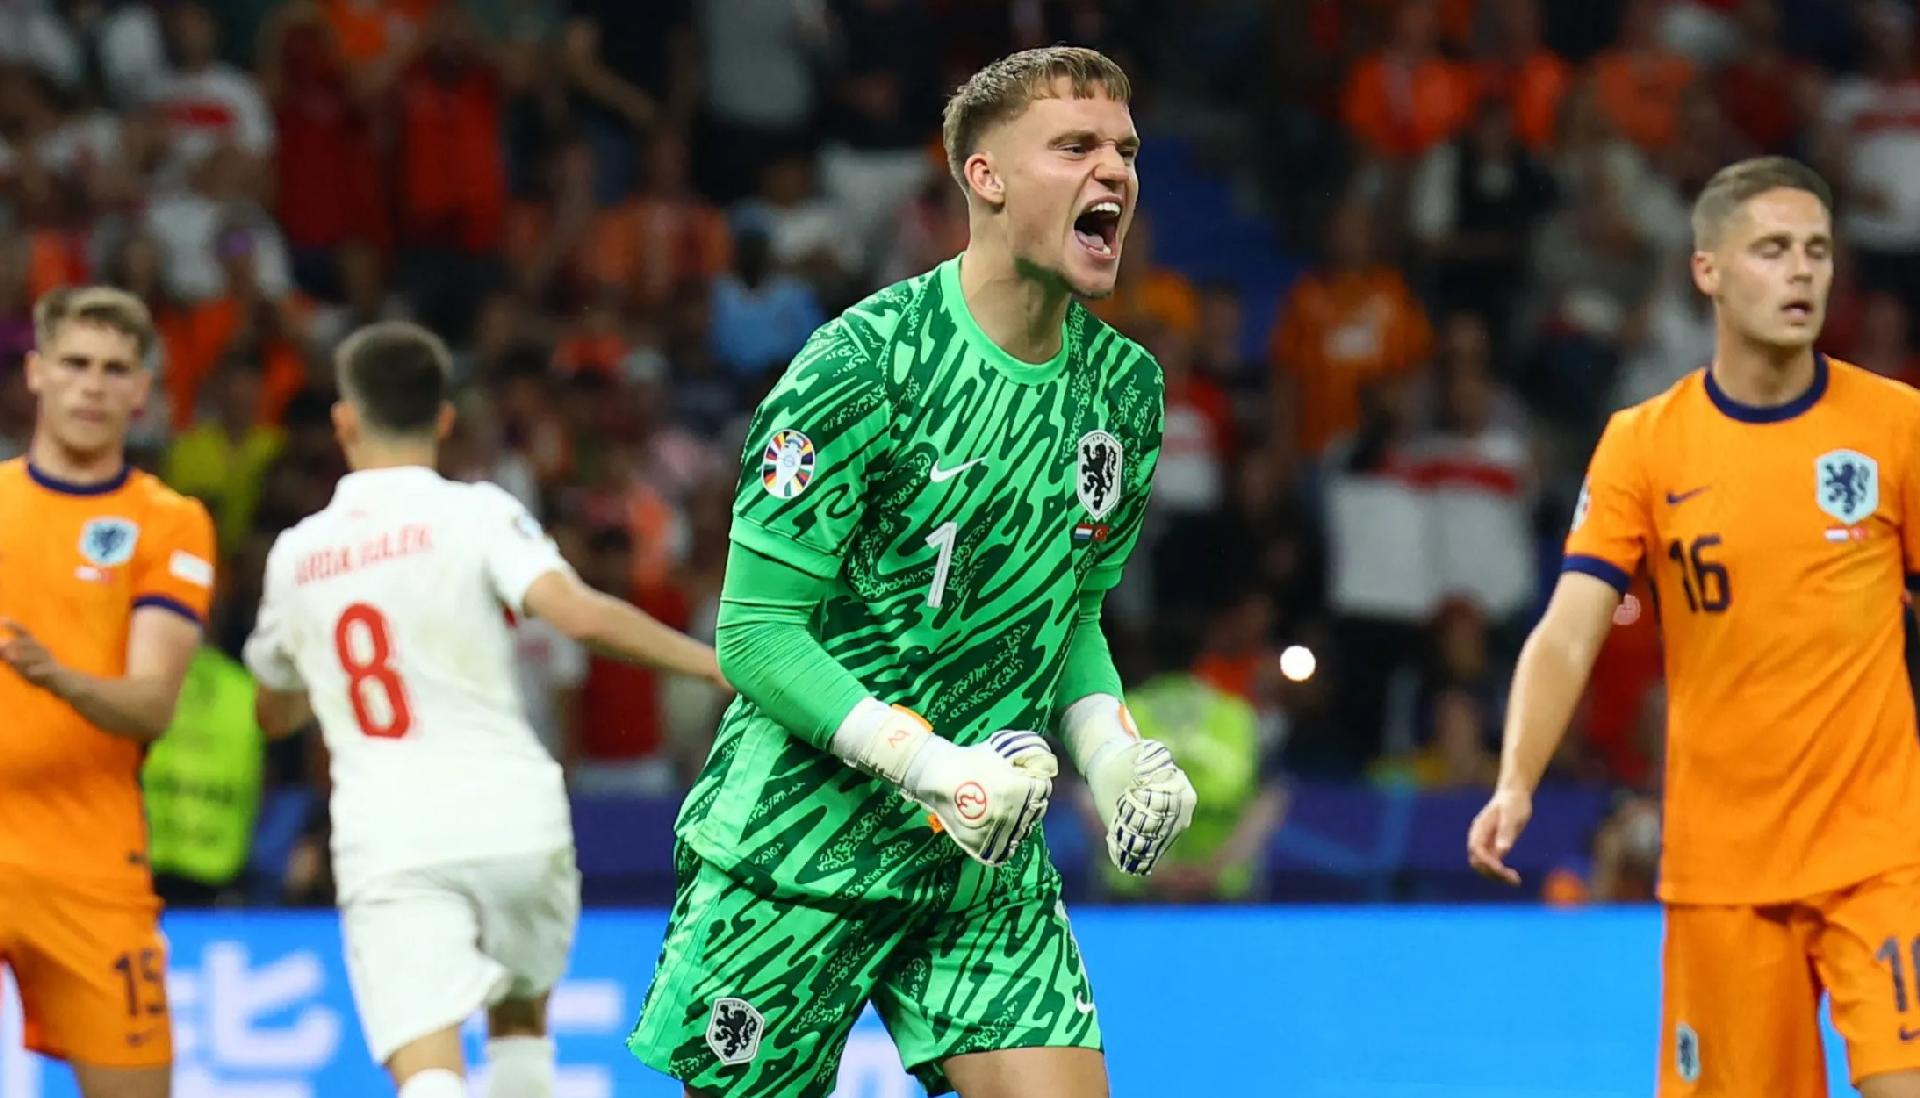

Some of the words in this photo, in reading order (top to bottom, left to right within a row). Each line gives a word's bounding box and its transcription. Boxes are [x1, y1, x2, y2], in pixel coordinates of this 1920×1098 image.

[925, 521, 958, 608] 1
[1668, 534, 1731, 613] 16
[335, 602, 411, 738] 8
[114, 948, 166, 1018] 15
